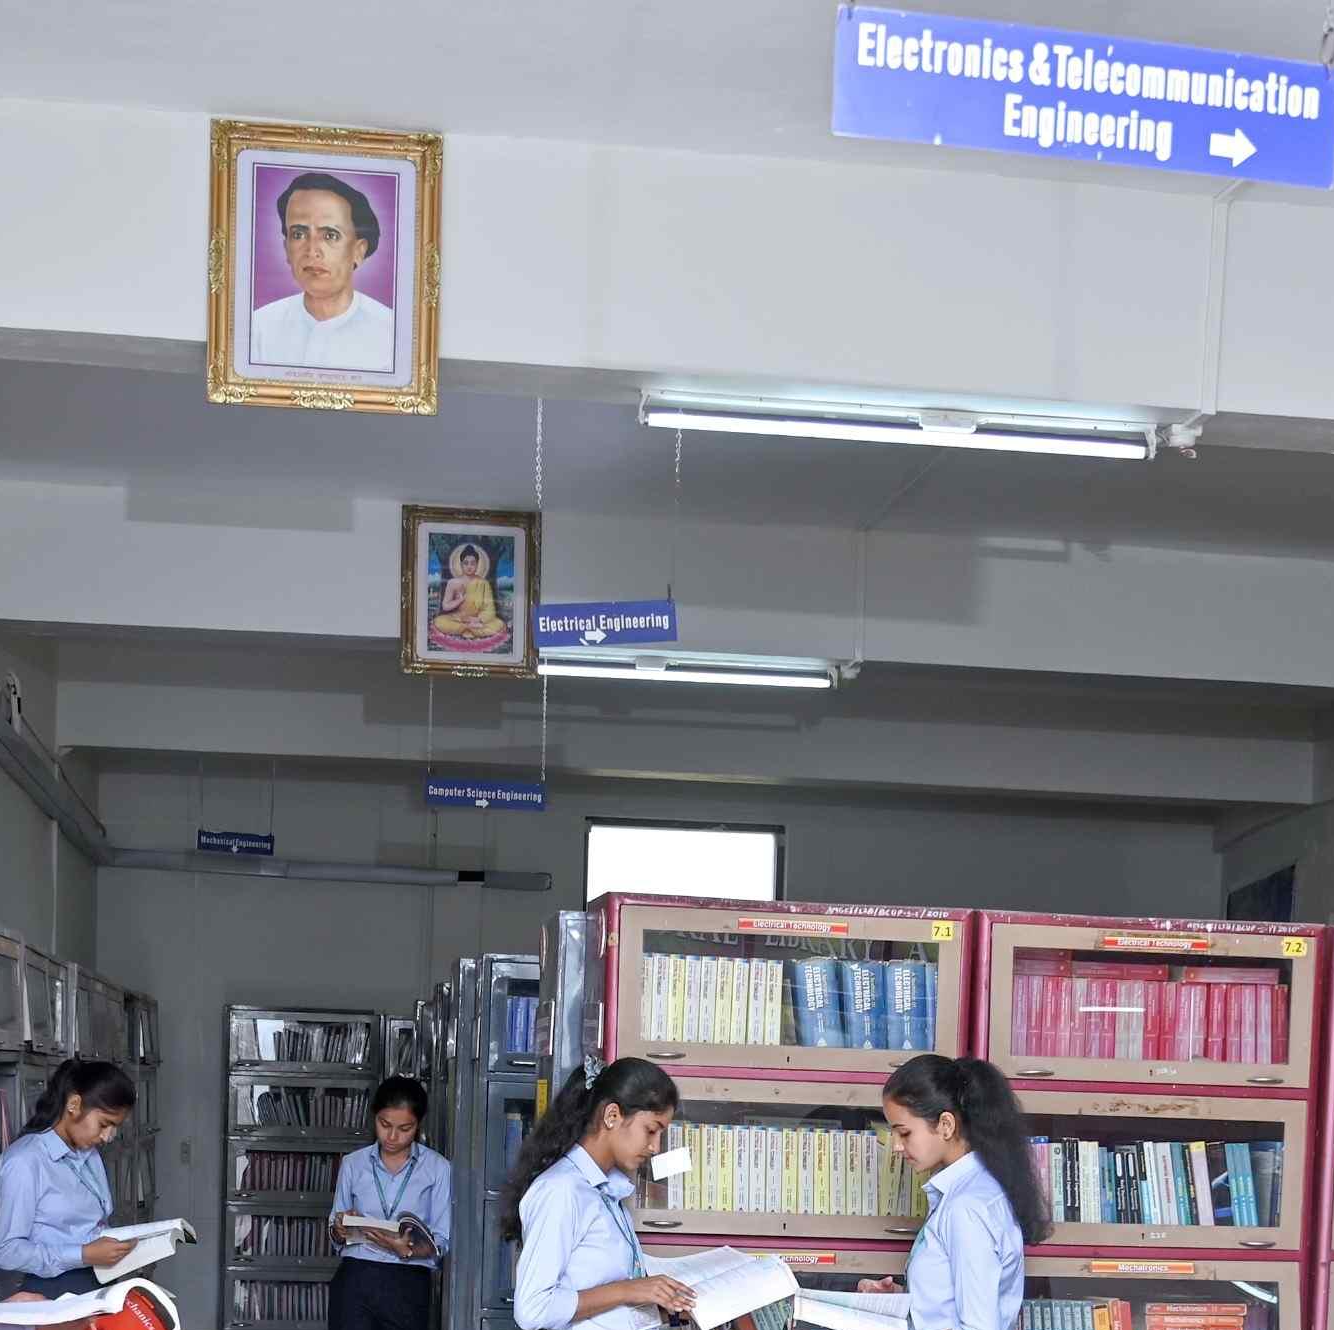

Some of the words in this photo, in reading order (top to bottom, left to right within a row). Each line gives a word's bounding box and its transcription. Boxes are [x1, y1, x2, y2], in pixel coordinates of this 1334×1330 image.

[857, 22, 1024, 84] Electronics
[1003, 93, 1174, 162] Engineering
[539, 615, 596, 633] Electrical
[599, 613, 670, 632] Engineering
[428, 785, 465, 797] Computer
[466, 787, 496, 799] Science
[497, 789, 542, 803] Engineering
[200, 835, 234, 846] Mechanical
[235, 837, 272, 849] Engineering
[753, 918, 786, 930] Electrical
[788, 920, 831, 933] Technology
[933, 925, 952, 938] 7.1
[1117, 938, 1152, 950] Electrical
[1154, 940, 1192, 953] Technology
[1285, 942, 1303, 953] 7.2
[804, 965, 815, 1011] TECHNOLOGY
[813, 967, 824, 1009] ELECTRICAL
[853, 966, 864, 1013] TECHNOLOGY
[862, 969, 872, 1011] ELECTRICAL
[895, 967, 905, 1013] TECHNOLOGY
[902, 968, 912, 1010] ELECTRICAL
[1117, 1263, 1169, 1273] Mechatronics
[1166, 1303, 1208, 1313] Mechatronics
